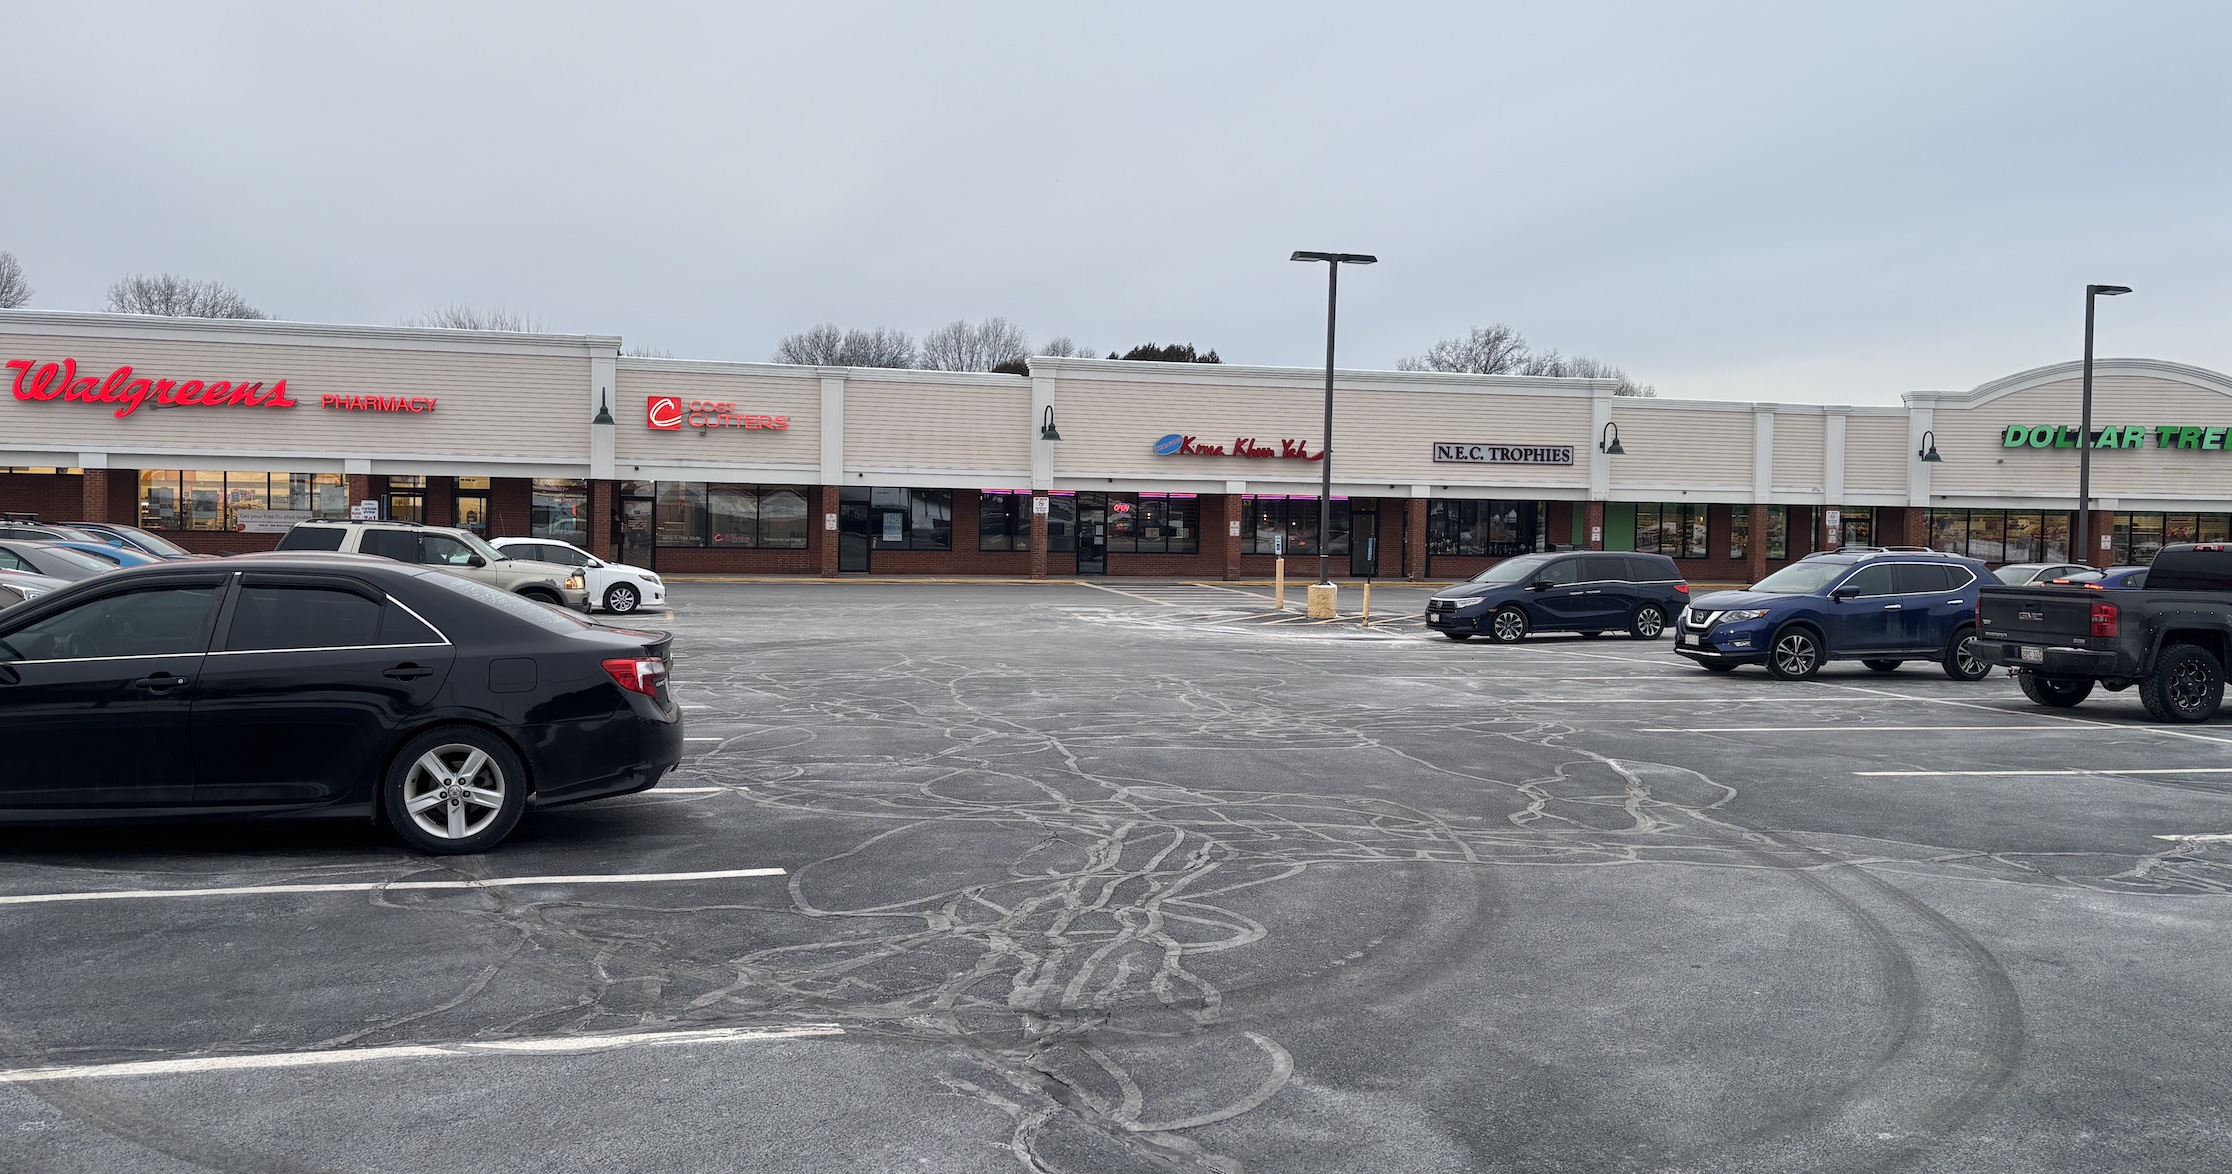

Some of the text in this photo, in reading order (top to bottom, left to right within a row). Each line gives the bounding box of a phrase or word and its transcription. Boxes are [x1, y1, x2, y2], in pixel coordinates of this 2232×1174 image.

[5, 357, 298, 419] Walgreens
[321, 393, 438, 414] PHARMACY
[688, 400, 737, 413] COST
[688, 413, 789, 431] CUTTERS
[1233, 437, 1275, 458] Khun
[1437, 445, 1570, 462] N.E.C. TROPHIES
[2018, 611, 2044, 621] GMC
